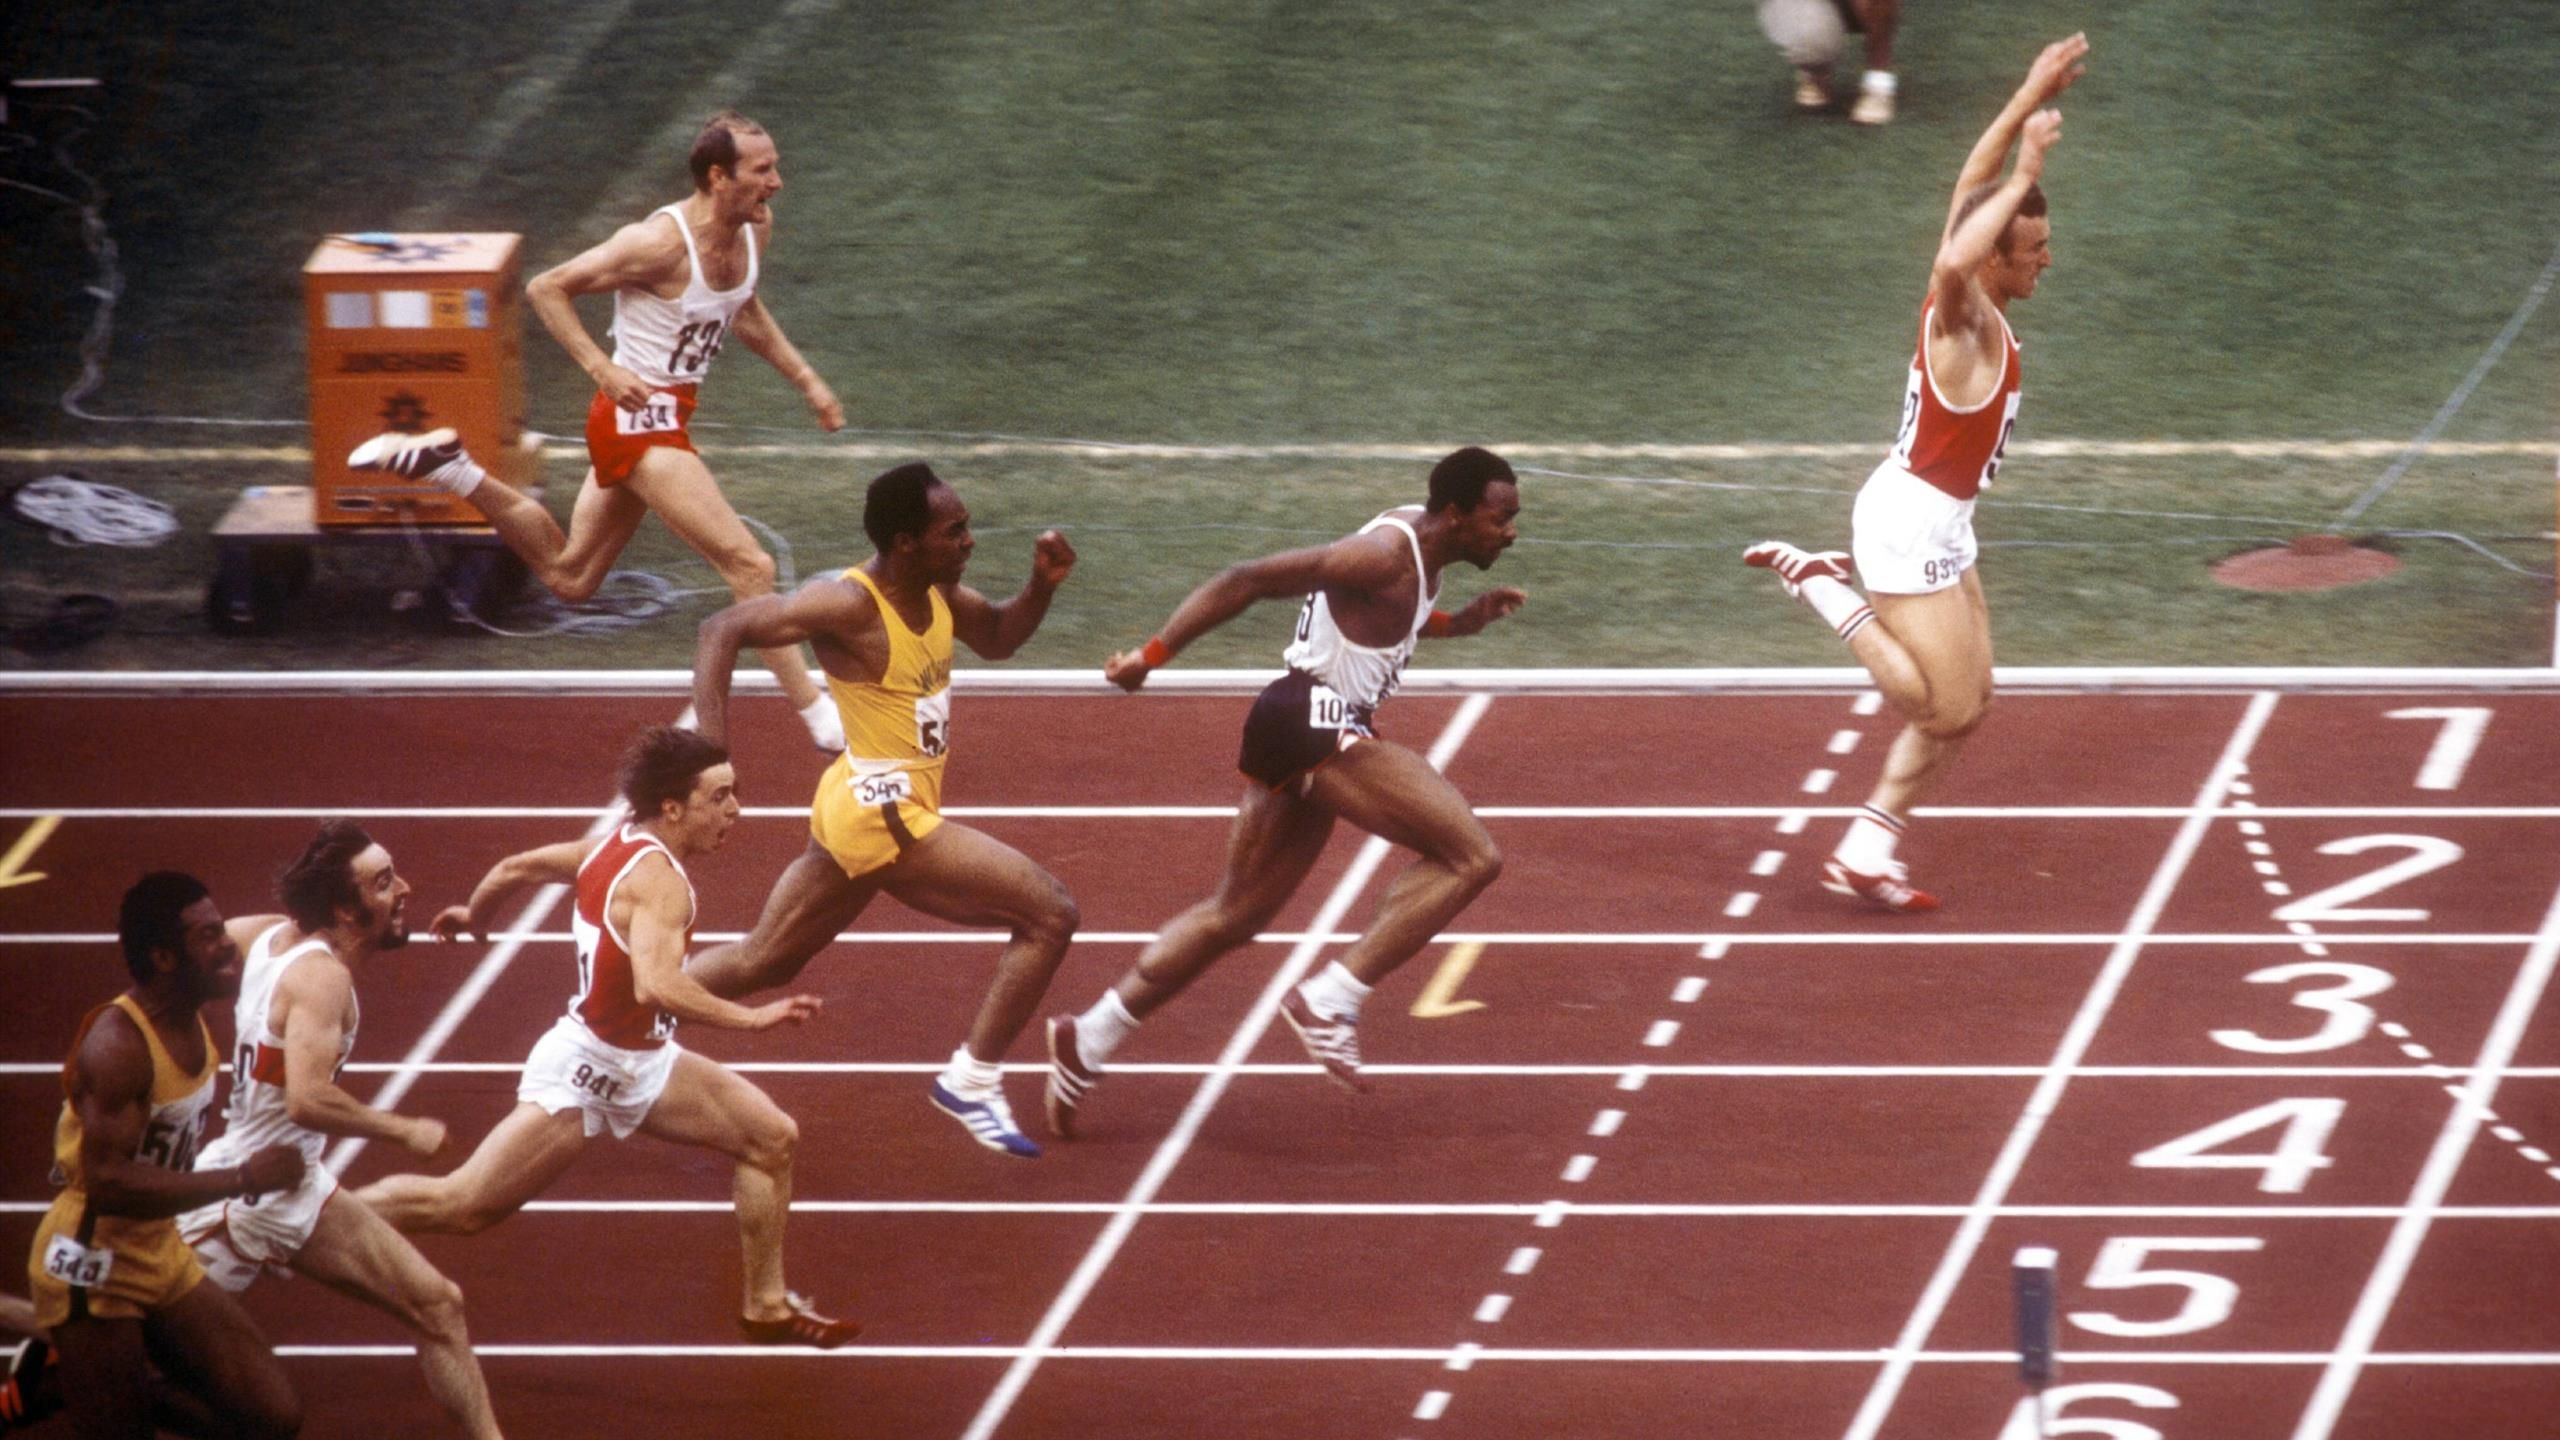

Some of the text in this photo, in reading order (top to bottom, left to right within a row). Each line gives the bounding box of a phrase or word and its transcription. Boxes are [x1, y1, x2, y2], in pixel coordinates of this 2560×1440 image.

[2382, 706, 2497, 790] 1
[2271, 833, 2466, 922] 2
[2208, 961, 2397, 1054] 3
[572, 1063, 621, 1101] 941
[2130, 1097, 2348, 1193] 4
[2066, 1236, 2267, 1338] 5
